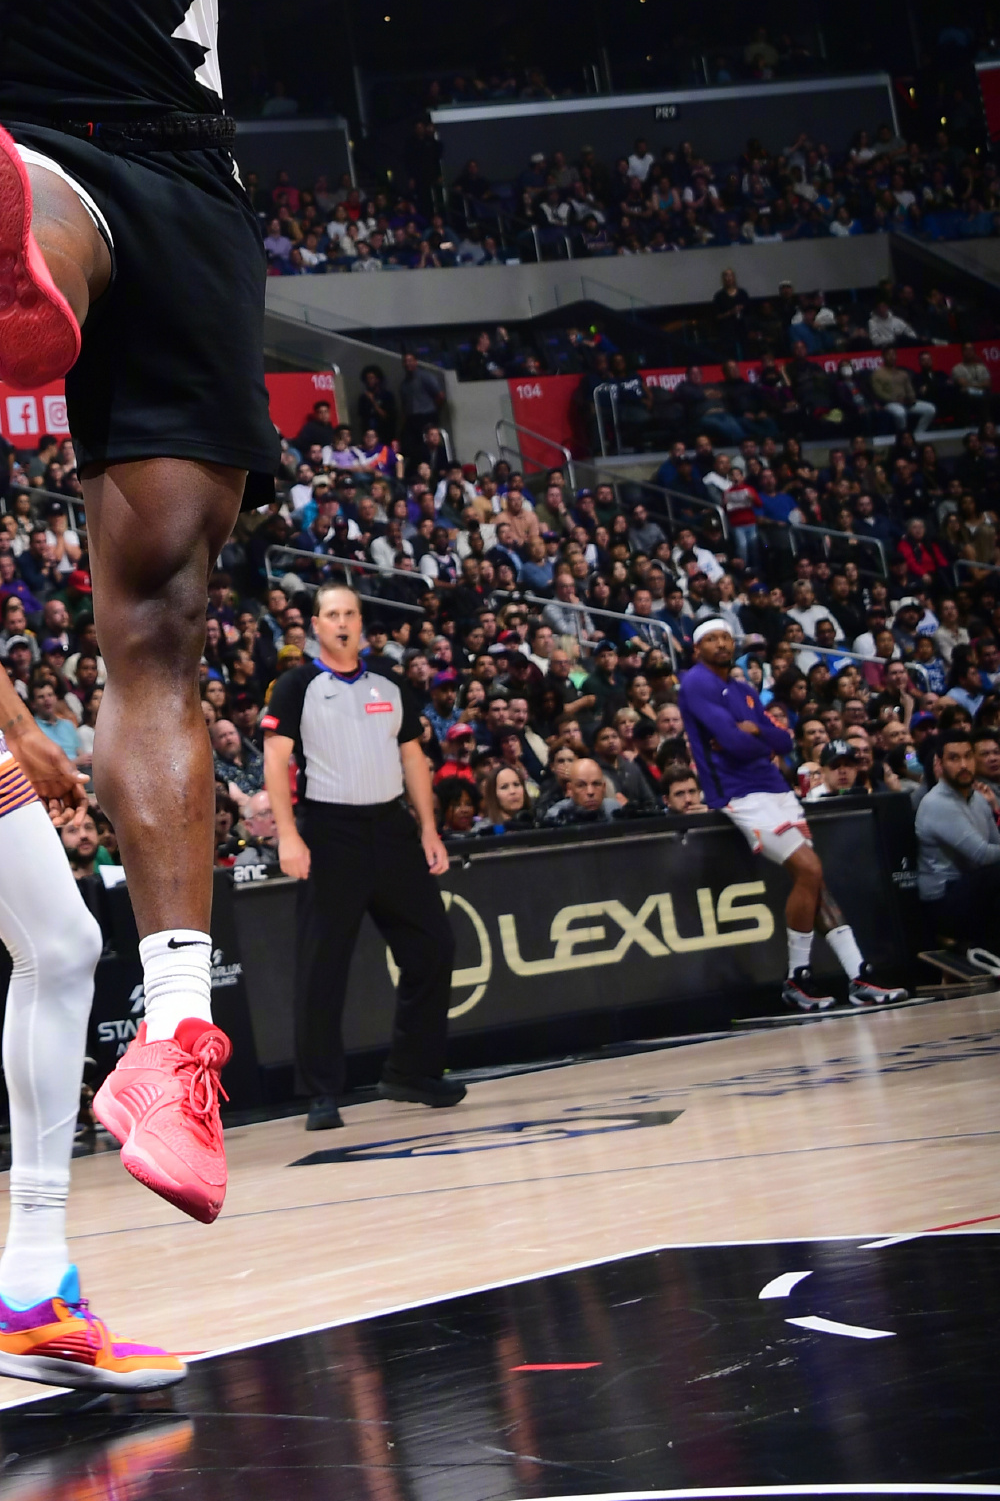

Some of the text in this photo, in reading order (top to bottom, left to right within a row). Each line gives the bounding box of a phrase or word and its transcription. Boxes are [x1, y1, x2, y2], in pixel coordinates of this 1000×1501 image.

[516, 383, 543, 399] 104
[234, 863, 268, 881] anc
[498, 881, 774, 977] LEXUS
